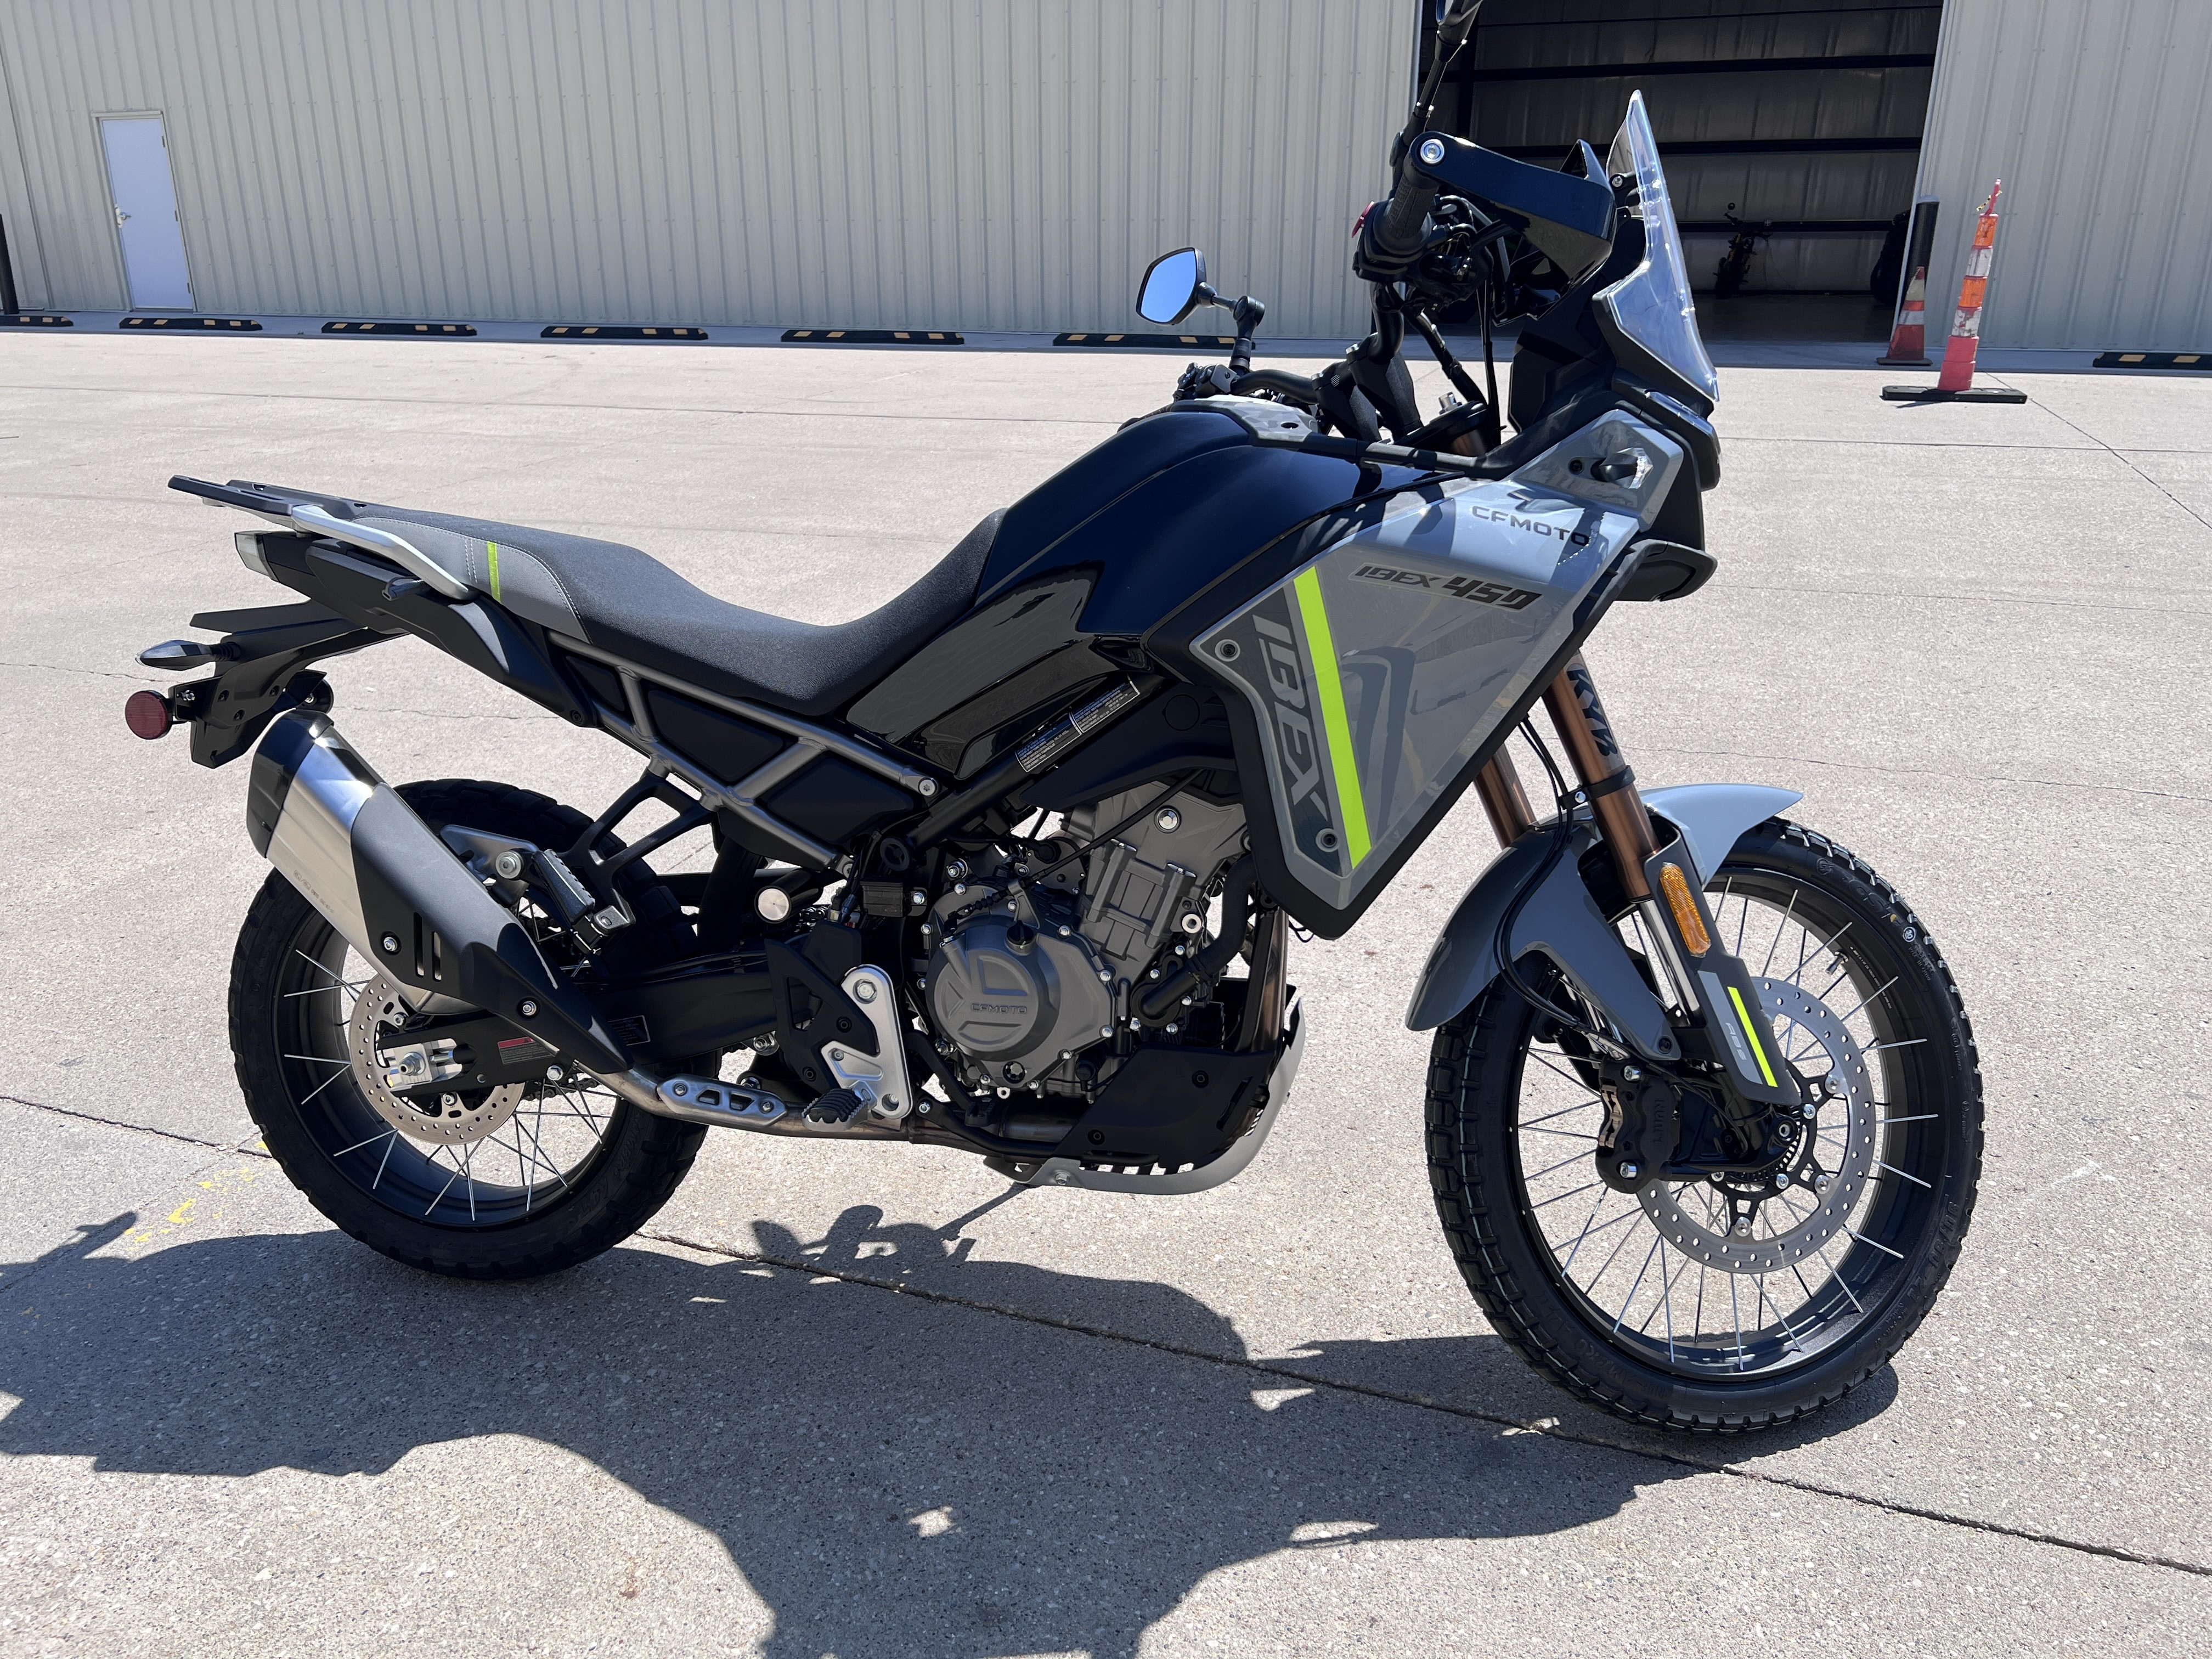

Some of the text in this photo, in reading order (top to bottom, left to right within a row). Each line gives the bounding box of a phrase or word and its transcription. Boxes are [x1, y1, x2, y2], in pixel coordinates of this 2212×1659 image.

[1471, 505, 1590, 546] CFMOTO
[1355, 565, 1542, 610] IBEX 450
[1252, 614, 1329, 822] IBEX
[1566, 669, 1618, 757] KYB
[970, 1002, 1028, 1014] CFMOTO
[1725, 1022, 1747, 1061] ABS
